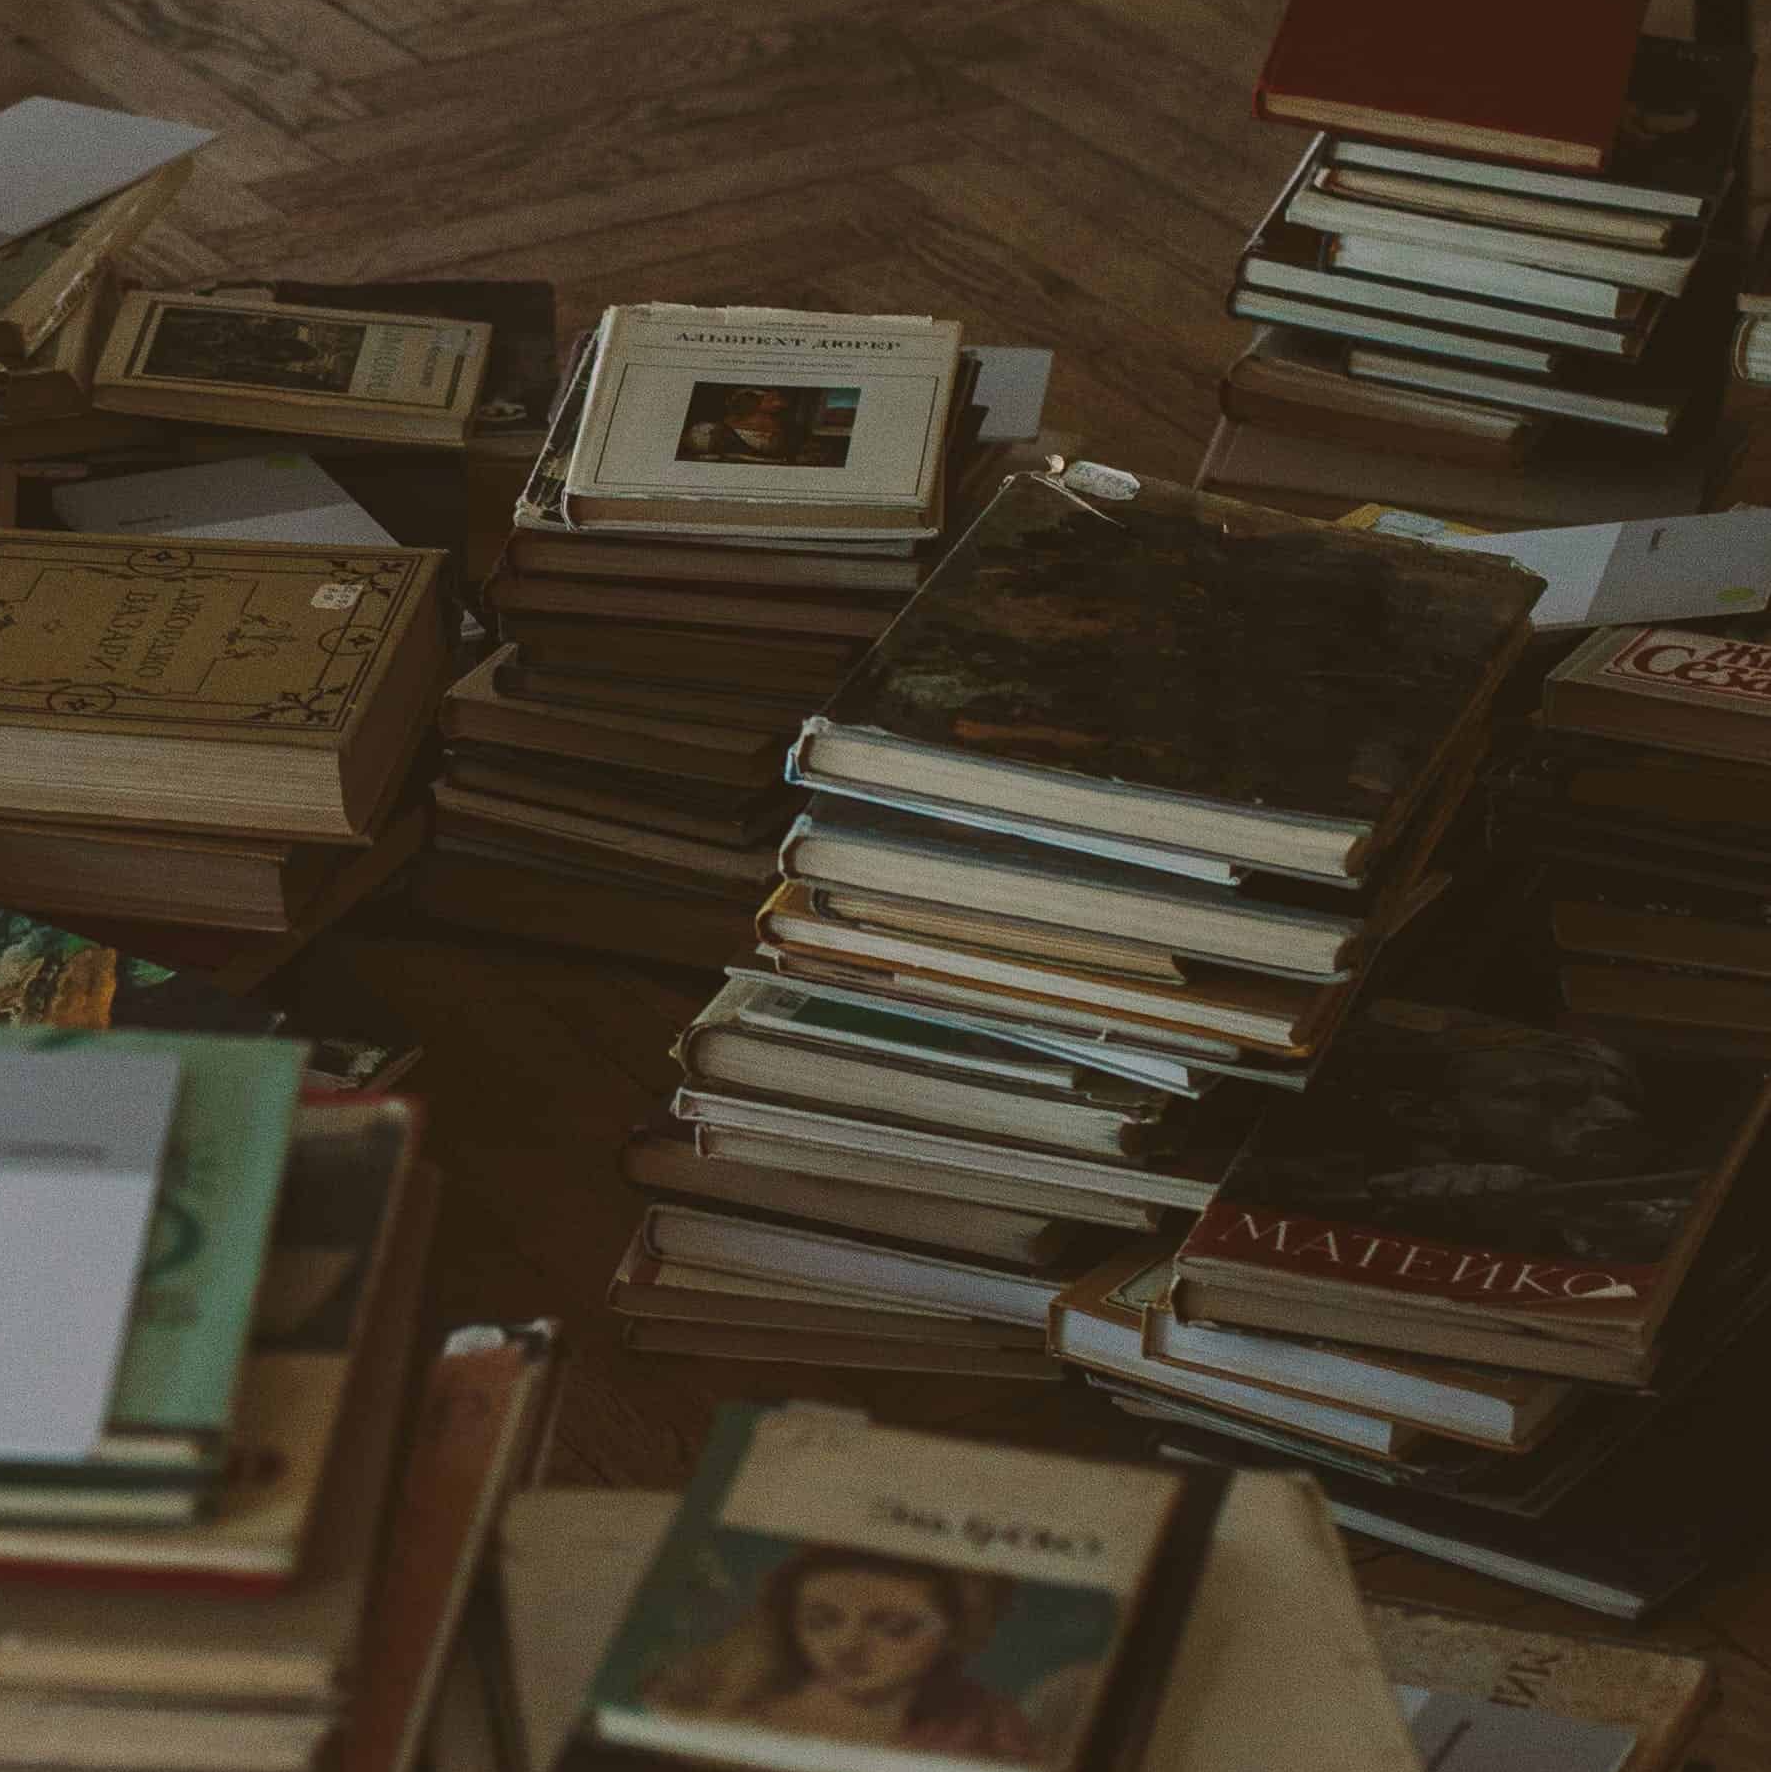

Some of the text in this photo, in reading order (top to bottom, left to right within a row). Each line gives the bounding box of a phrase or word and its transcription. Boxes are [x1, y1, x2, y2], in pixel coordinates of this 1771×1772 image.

[677, 331, 902, 350] АЛЬБРЕХТ ДЮРЕР
[1220, 1212, 1617, 1299] МАТЕЙКО
